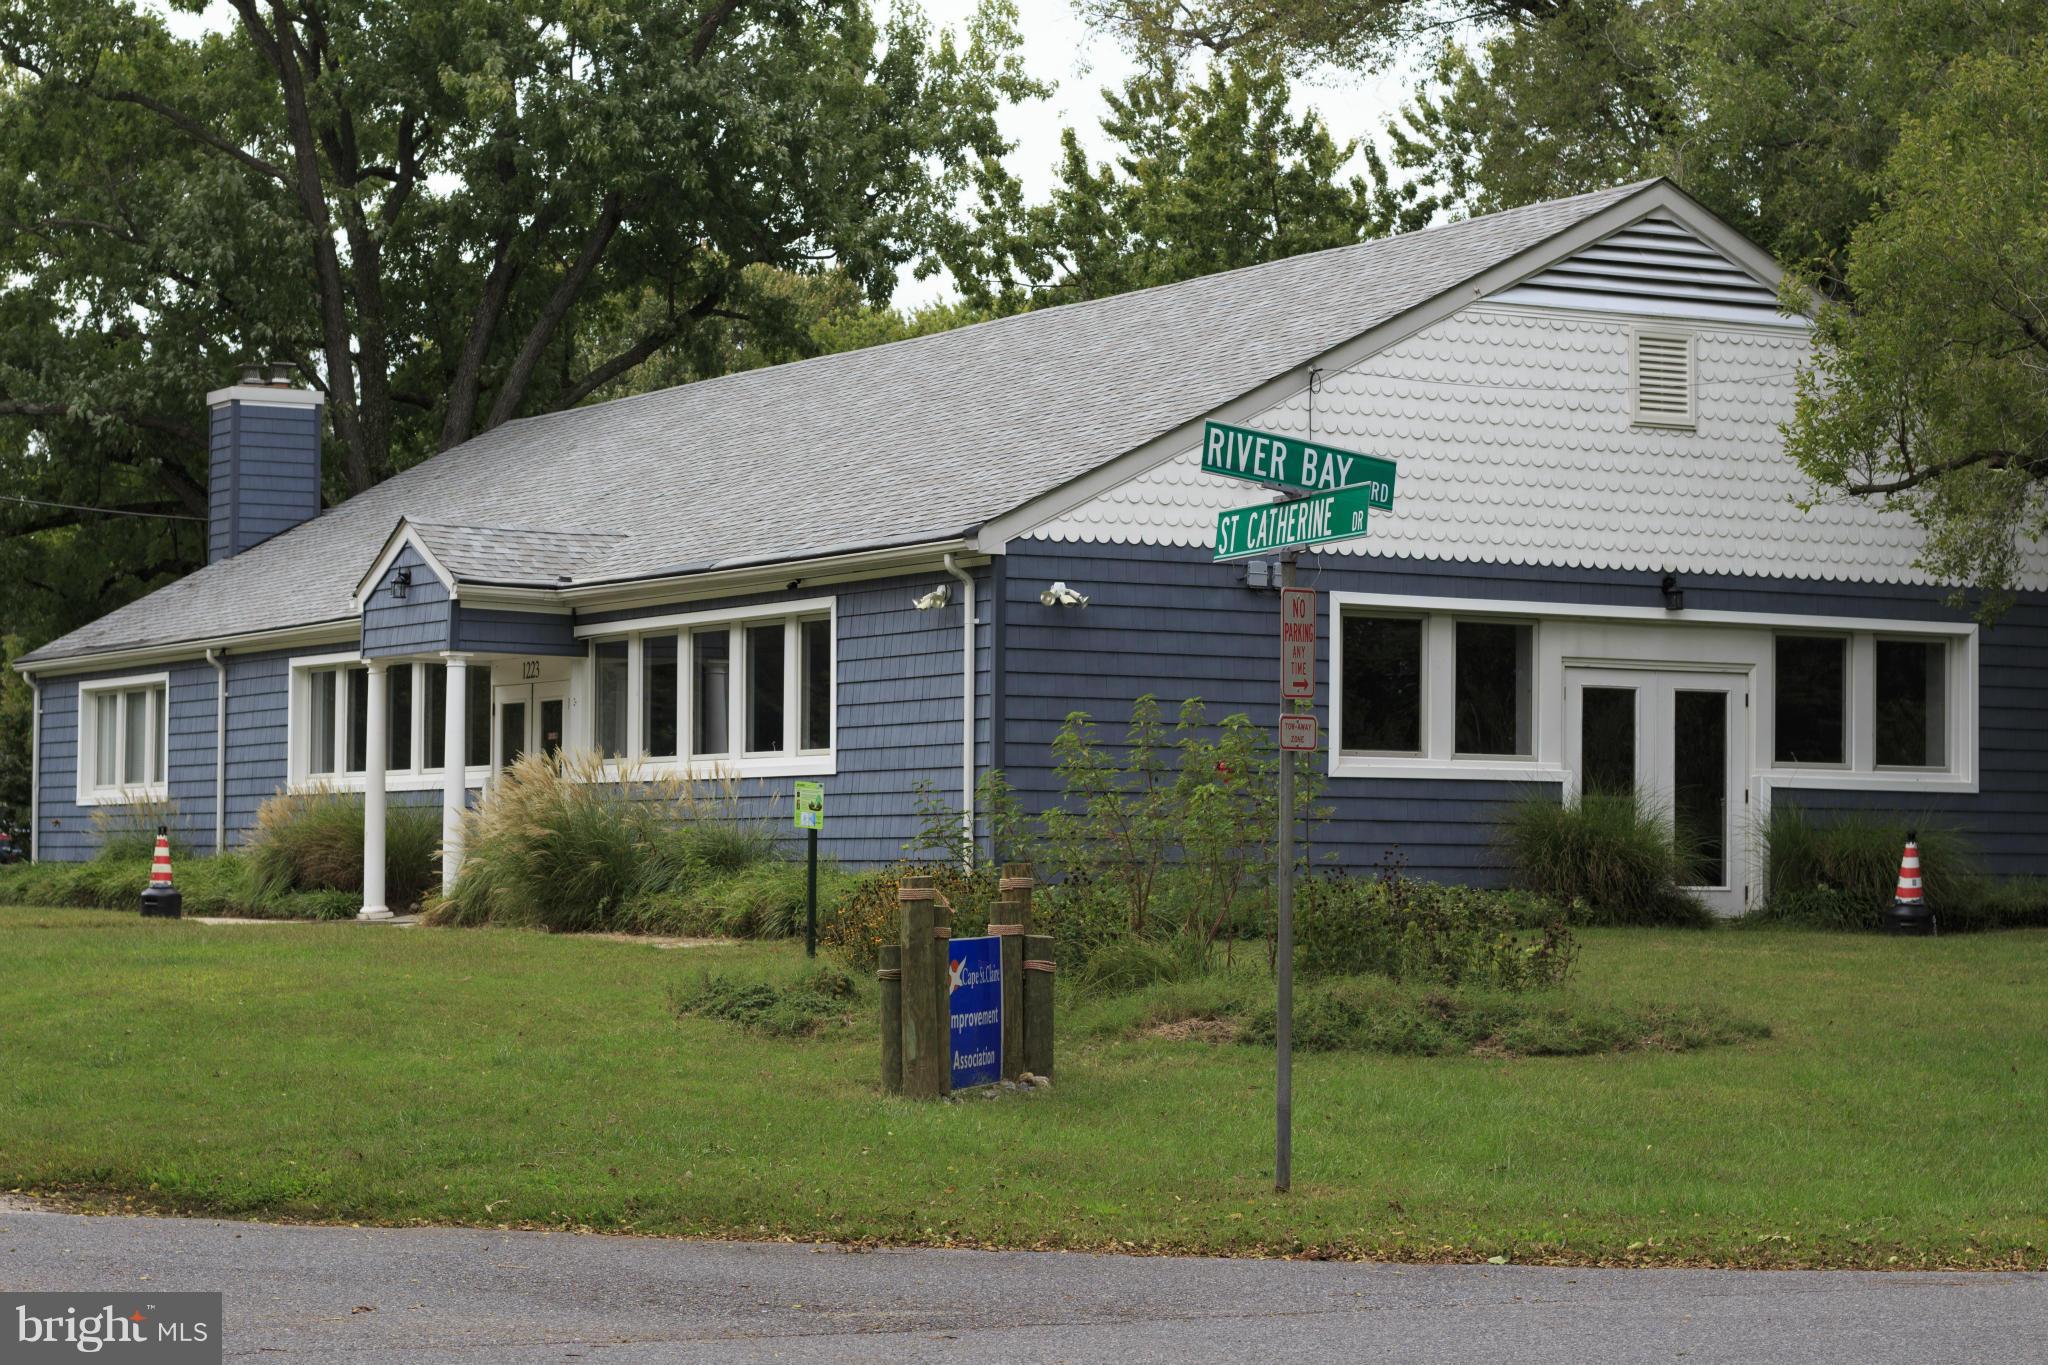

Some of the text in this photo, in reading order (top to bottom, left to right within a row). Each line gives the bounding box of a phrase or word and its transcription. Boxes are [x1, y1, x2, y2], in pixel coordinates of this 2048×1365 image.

[1207, 427, 1389, 503] RIVER BAY RD
[1218, 497, 1364, 555] ST CATHERINE DR
[1292, 599, 1306, 618] NO
[1284, 622, 1314, 643] PARKING
[1292, 645, 1306, 659] ANY
[522, 660, 540, 679] 1223
[1291, 661, 1307, 675] TIME
[1285, 722, 1312, 730] TOW-AWAY
[1290, 735, 1305, 744] ZONE
[962, 967, 979, 989] Cape
[950, 1007, 998, 1035] mprovement
[953, 1045, 995, 1071] Association
